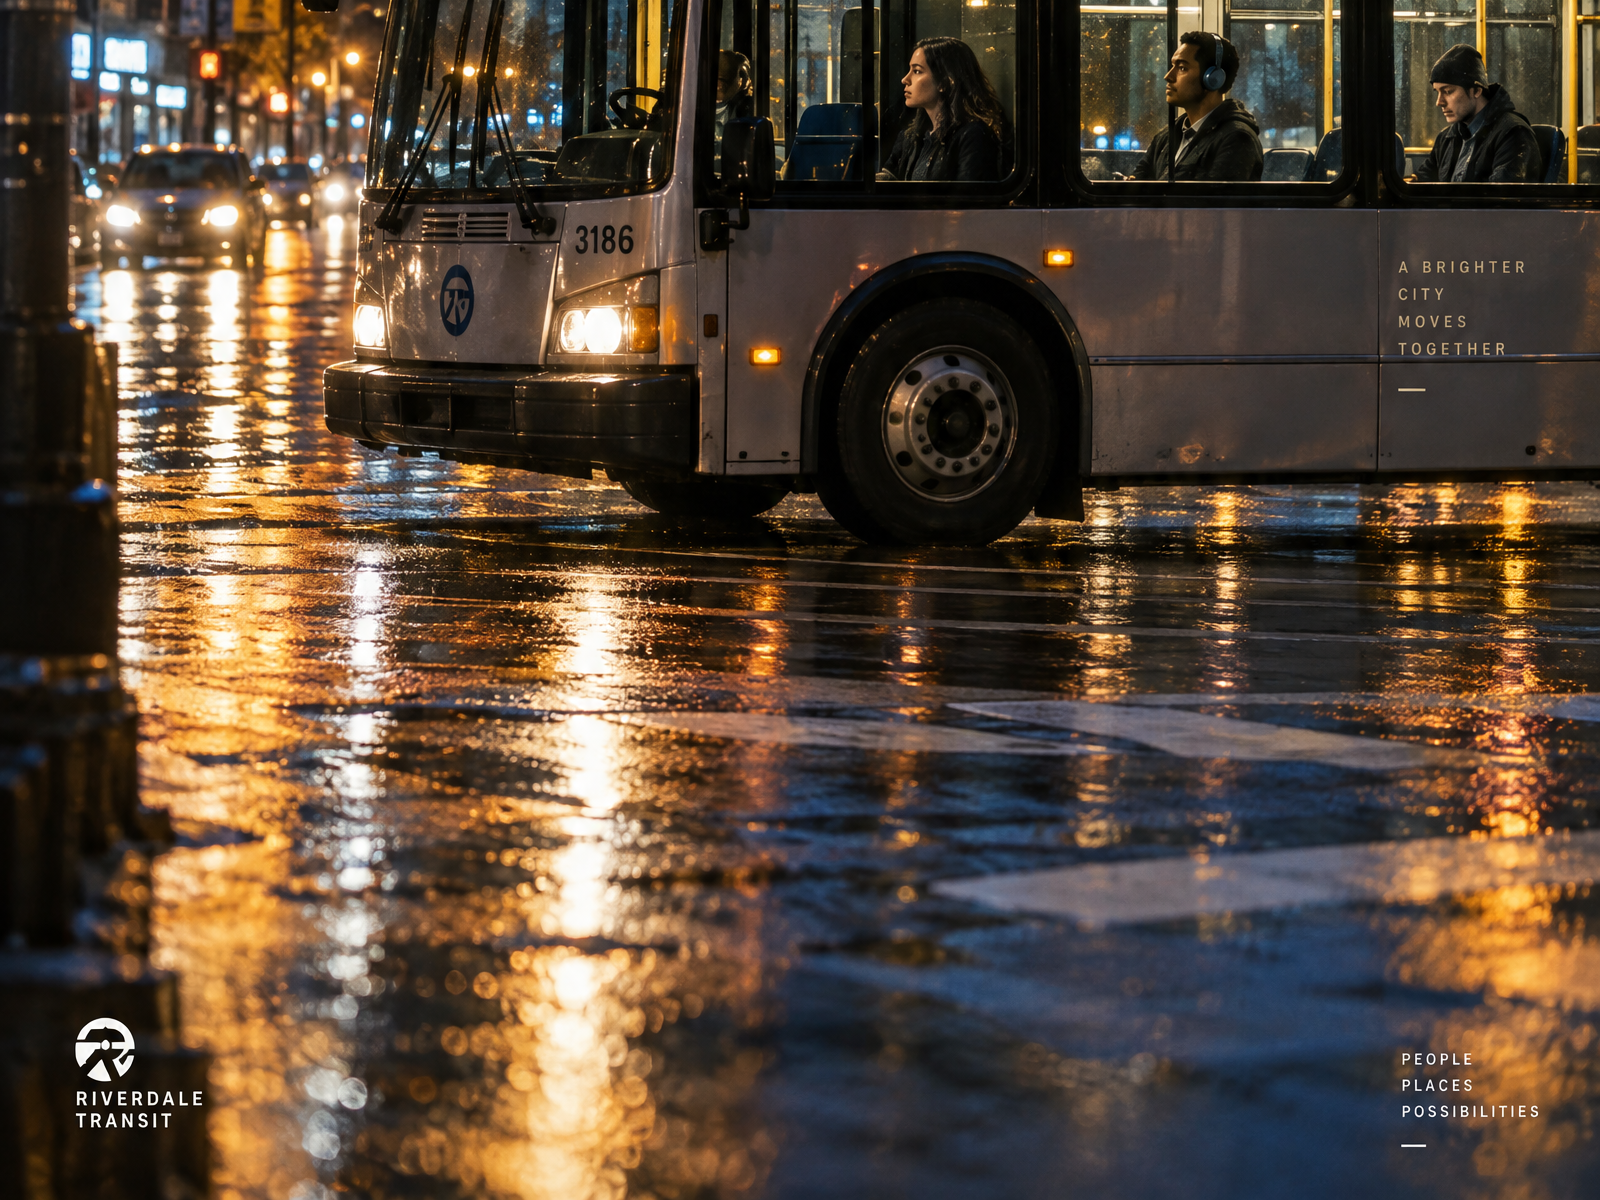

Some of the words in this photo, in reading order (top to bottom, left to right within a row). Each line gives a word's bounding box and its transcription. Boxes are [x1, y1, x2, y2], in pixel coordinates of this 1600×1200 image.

[575, 224, 634, 255] 3186
[1398, 260, 1408, 274] A
[1422, 260, 1526, 274] BRIGHTER
[1398, 287, 1445, 301] CITY
[1398, 315, 1467, 328] MOVES
[1398, 342, 1507, 356] TOGETHER
